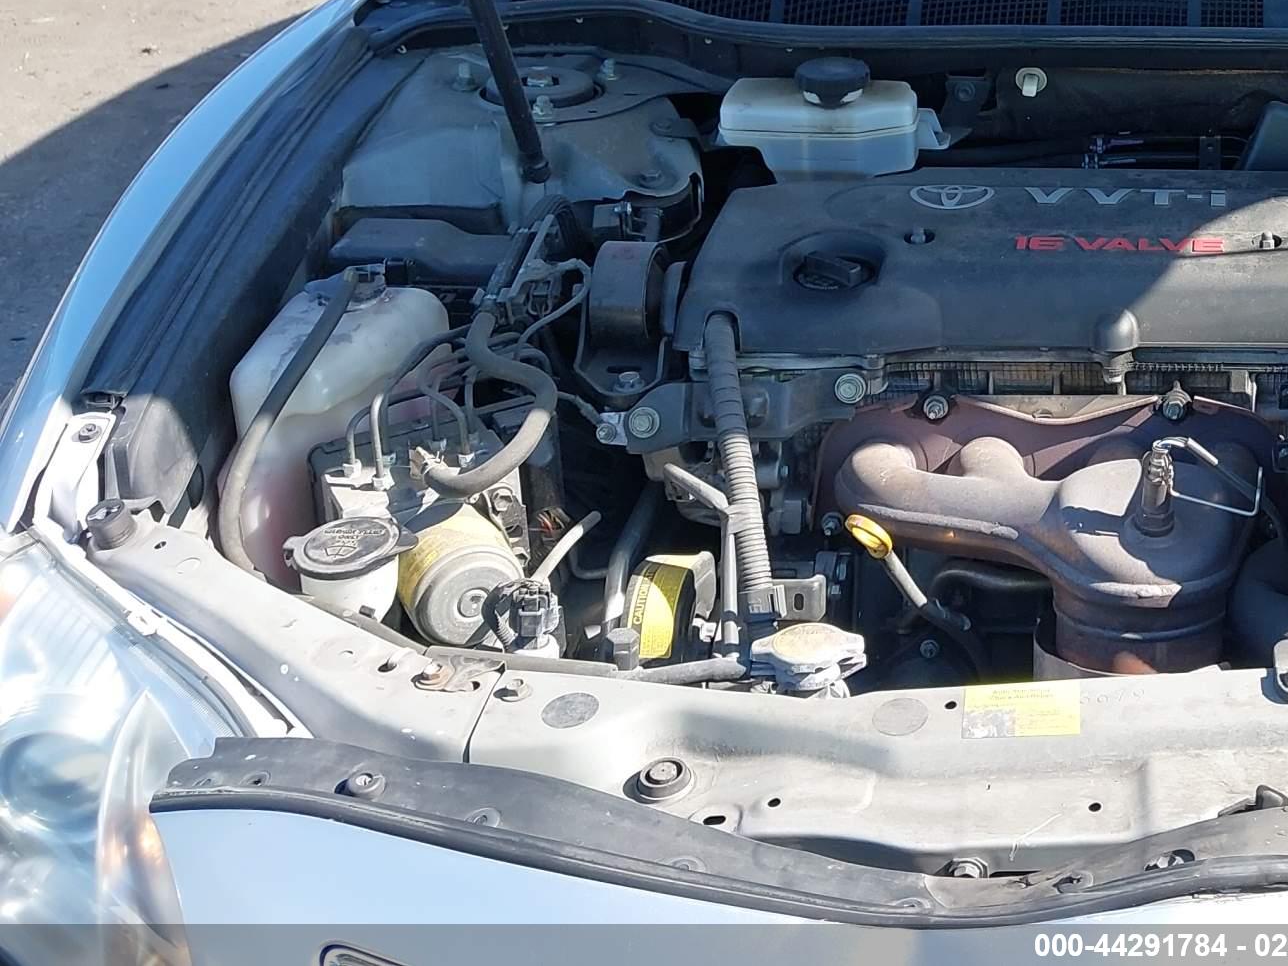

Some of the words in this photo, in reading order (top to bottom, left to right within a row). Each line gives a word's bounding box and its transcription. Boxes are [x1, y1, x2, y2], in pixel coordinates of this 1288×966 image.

[1016, 235, 1067, 251] 16
[1074, 237, 1225, 254] VALVE
[633, 582, 650, 625] CAUTION
